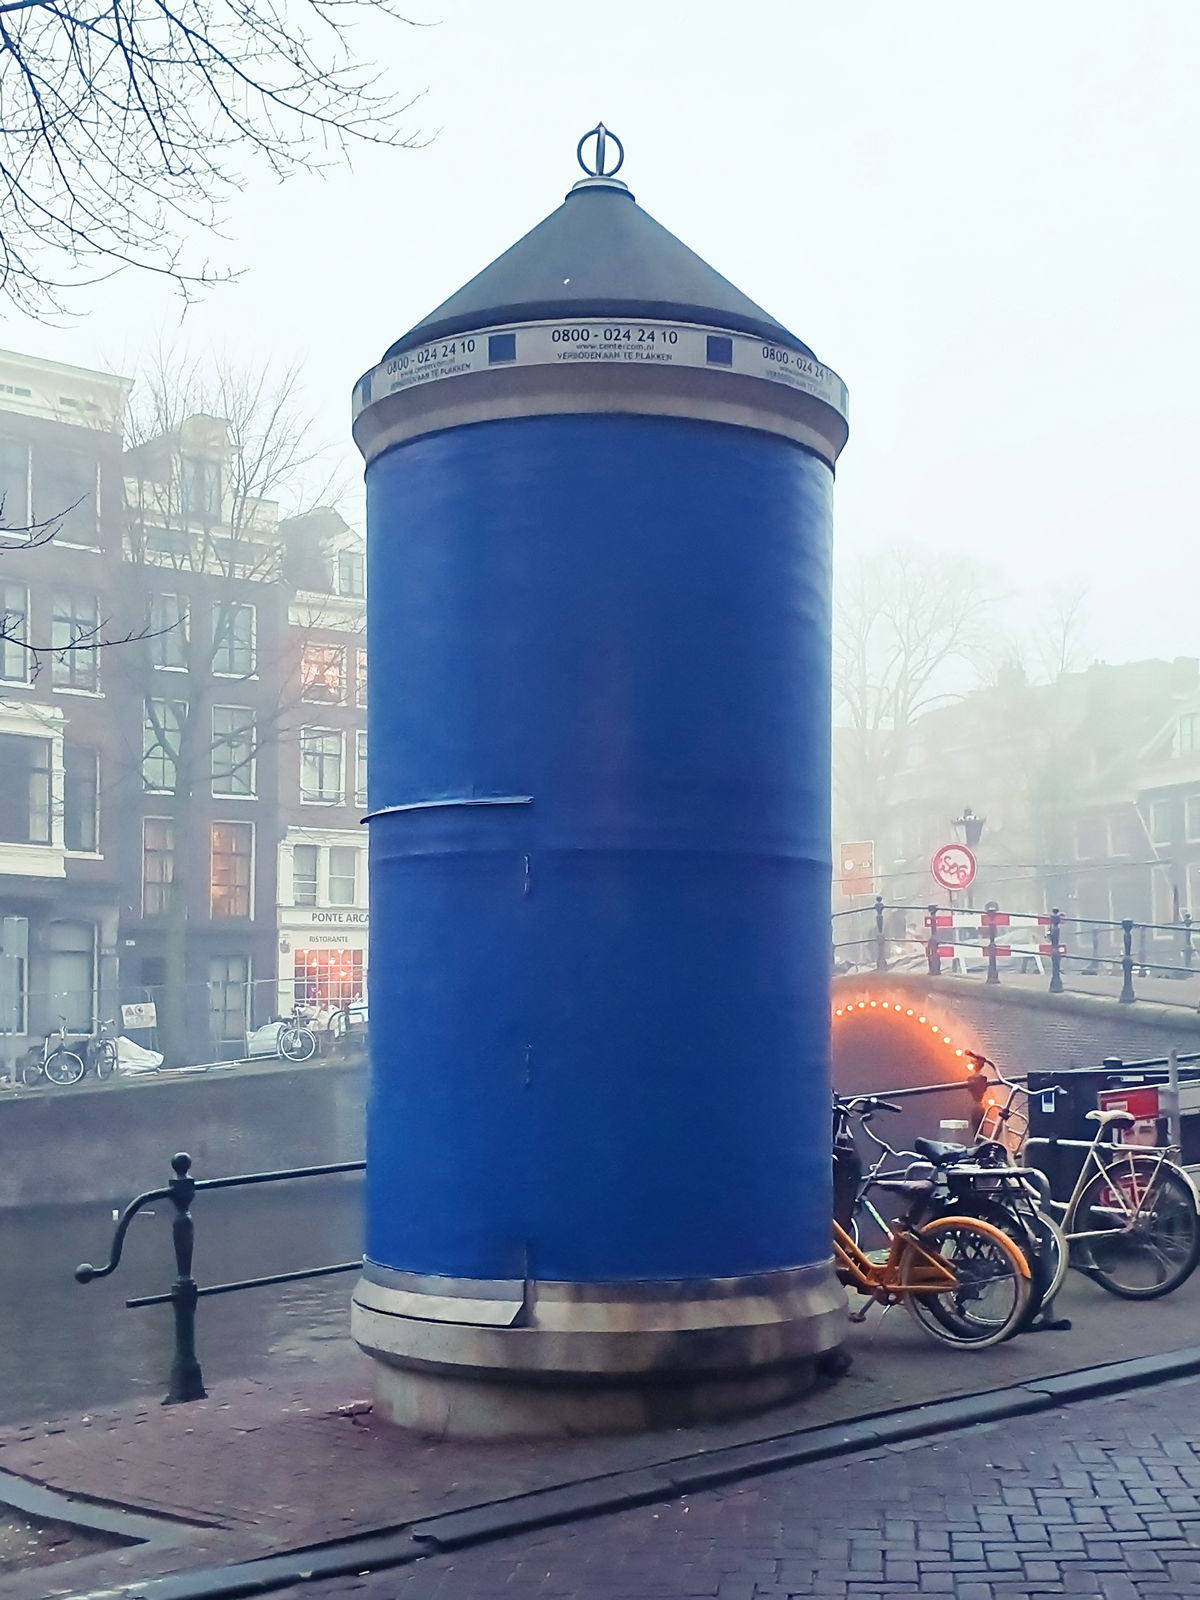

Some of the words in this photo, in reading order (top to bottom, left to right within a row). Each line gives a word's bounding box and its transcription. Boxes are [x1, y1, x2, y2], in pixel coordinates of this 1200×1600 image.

[551, 328, 590, 343] 0800
[603, 328, 631, 341] 024
[638, 328, 655, 342] 24
[661, 330, 678, 345] 10
[387, 356, 409, 375] 0800
[417, 348, 437, 364] 024
[442, 342, 456, 358] 24
[461, 339, 475, 353] 10
[635, 352, 673, 361] PLAKKEN
[762, 346, 789, 364] 0800
[796, 357, 813, 374] 024
[311, 912, 344, 923] PONTE
[309, 935, 349, 943] RISTORANTE
